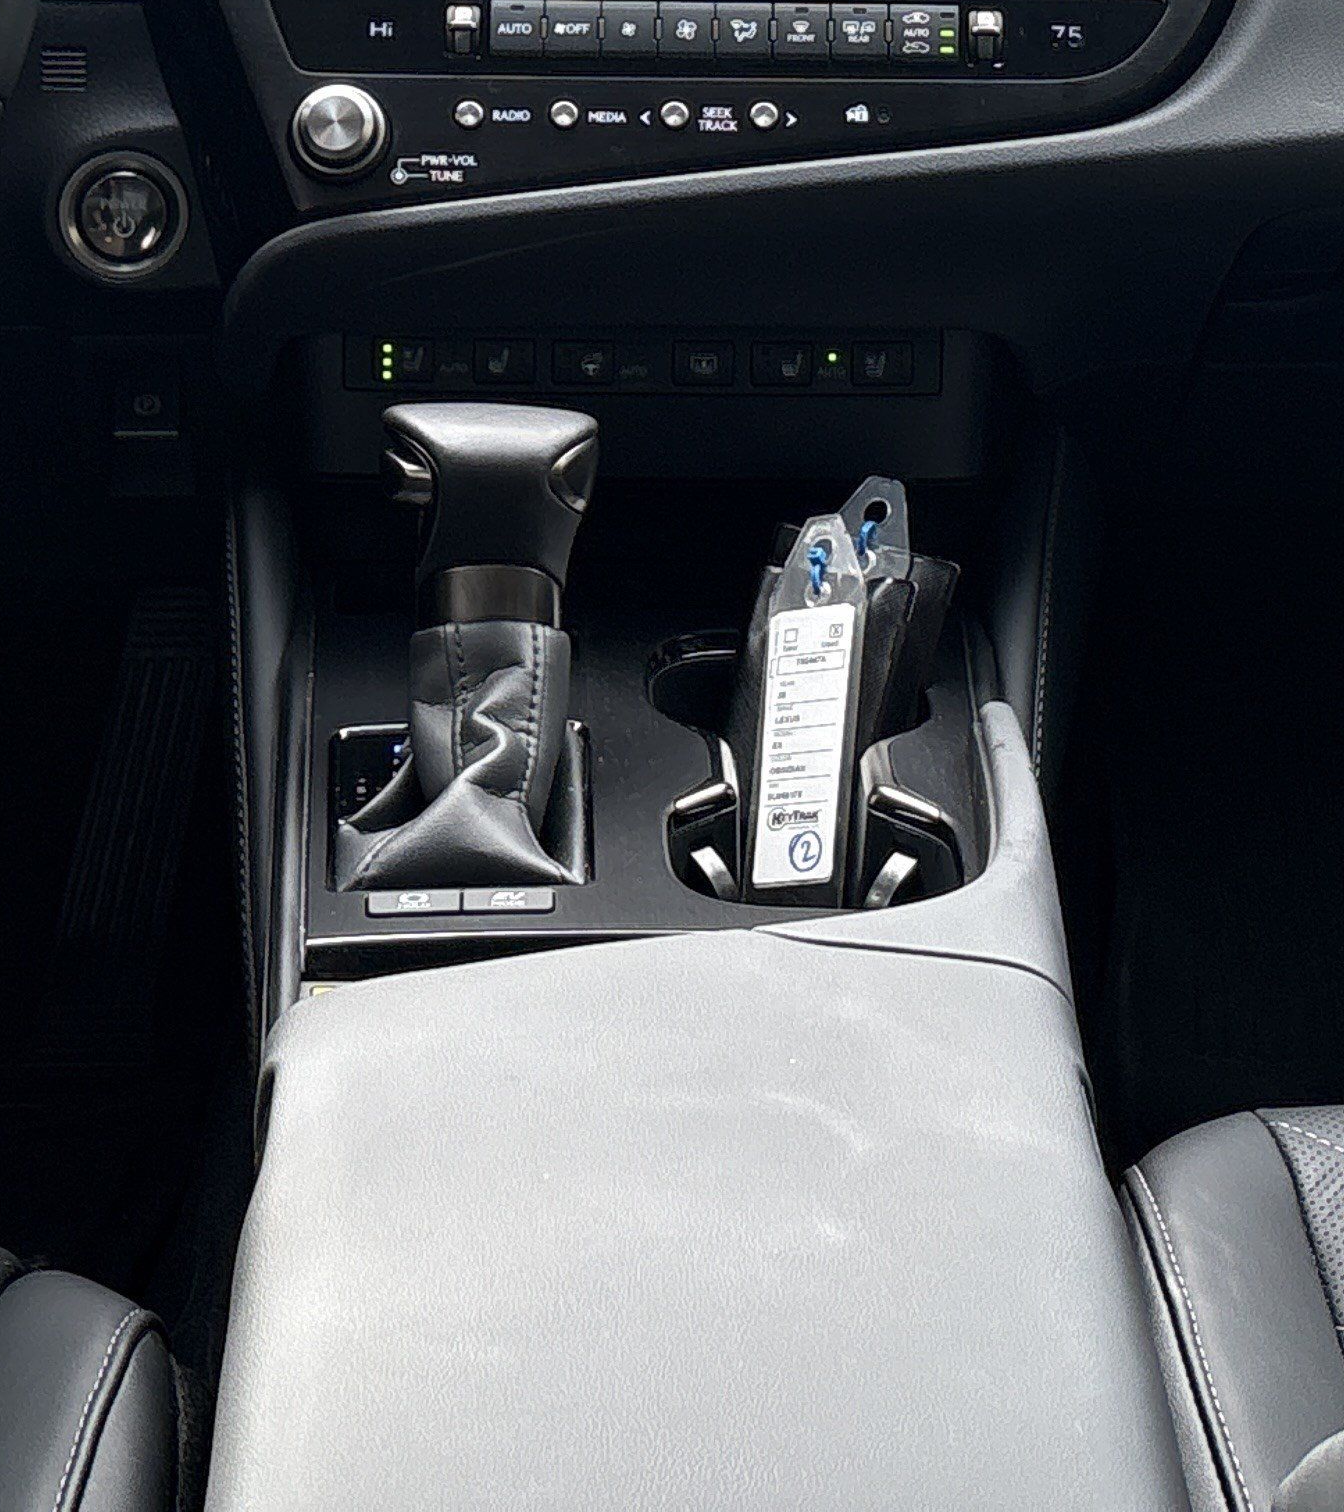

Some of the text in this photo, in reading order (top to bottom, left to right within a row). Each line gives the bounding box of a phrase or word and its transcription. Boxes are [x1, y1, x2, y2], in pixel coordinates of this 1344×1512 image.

[497, 22, 533, 35] AUTO
[567, 23, 591, 35] OFF
[903, 27, 930, 38] AUTO
[787, 33, 815, 43] FRONT
[847, 34, 870, 43] REAR
[1050, 25, 1083, 48] 75
[492, 109, 531, 122] RADIO
[587, 111, 627, 124] MEDIA
[702, 106, 732, 119] SEEK
[697, 119, 738, 133] TRACK
[429, 170, 464, 183] TUNE
[800, 839, 817, 863] 2
